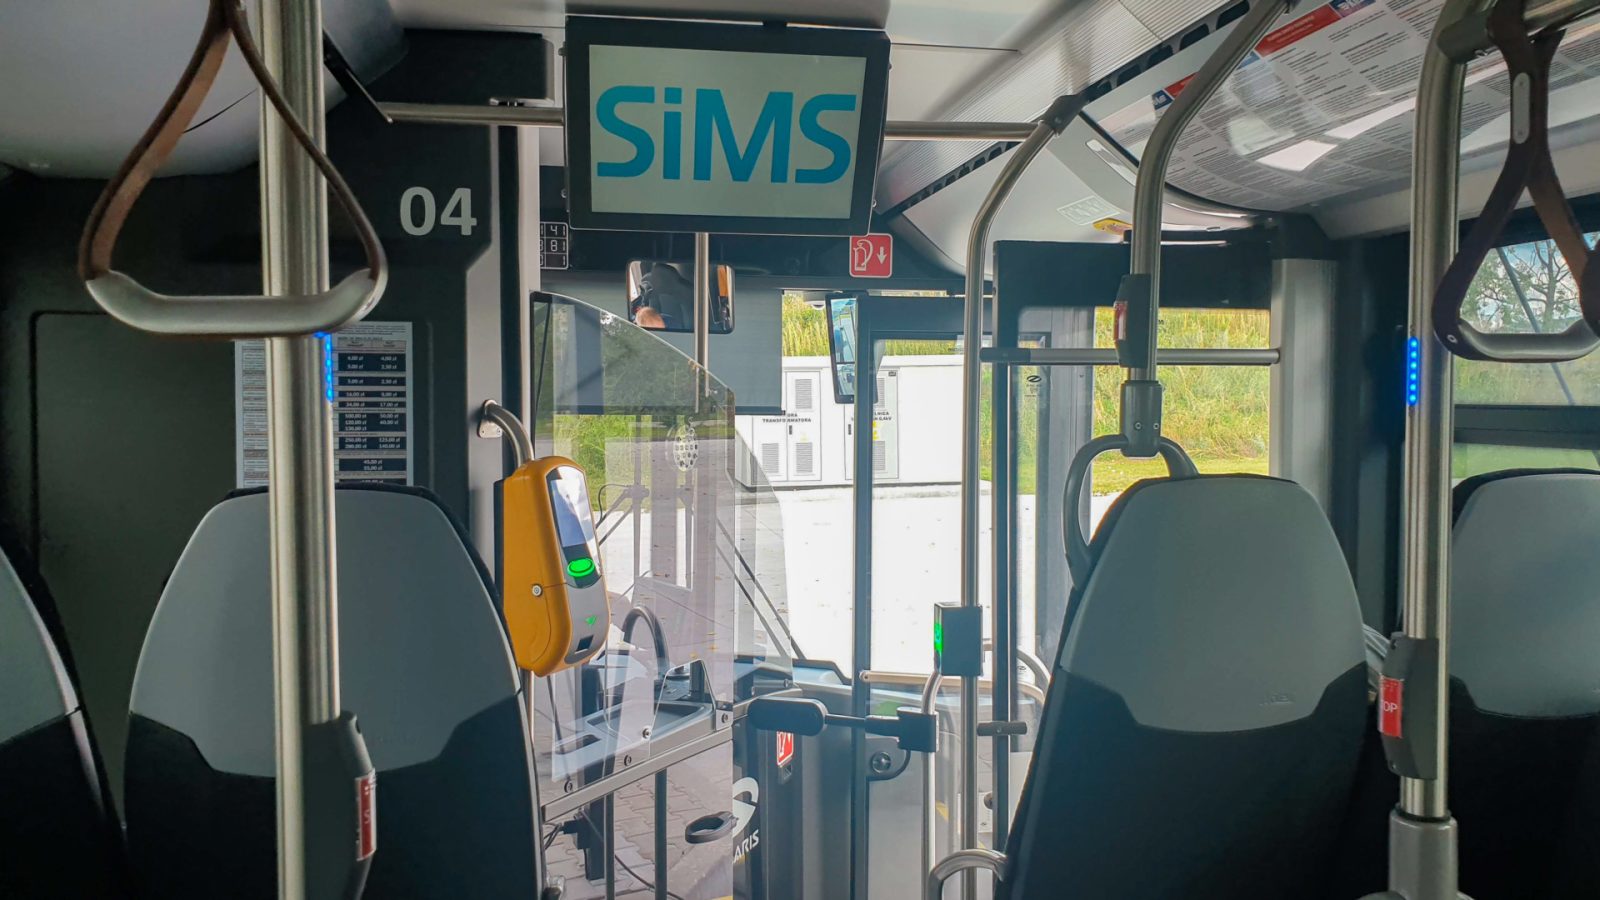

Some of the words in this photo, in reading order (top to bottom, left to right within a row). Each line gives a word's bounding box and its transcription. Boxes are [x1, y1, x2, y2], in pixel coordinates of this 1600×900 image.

[596, 85, 857, 184] SiMS
[400, 186, 477, 236] 04
[1383, 701, 1398, 713] OP
[732, 829, 759, 864] ARIS
